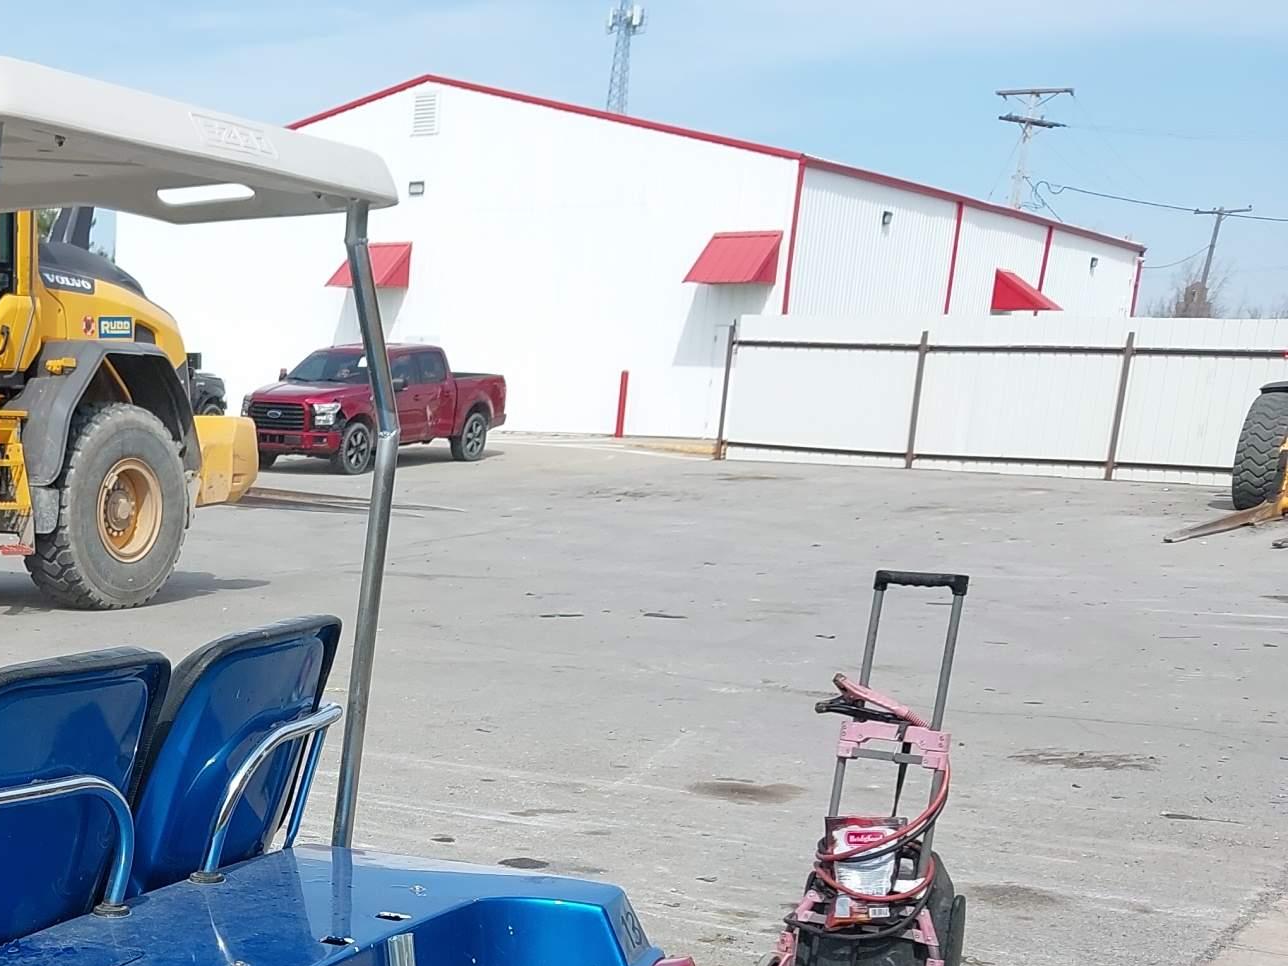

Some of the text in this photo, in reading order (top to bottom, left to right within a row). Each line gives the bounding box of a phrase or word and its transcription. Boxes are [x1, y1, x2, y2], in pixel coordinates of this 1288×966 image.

[42, 272, 92, 290] VOLVO
[100, 320, 131, 334] RUDD
[620, 911, 642, 949] 13
